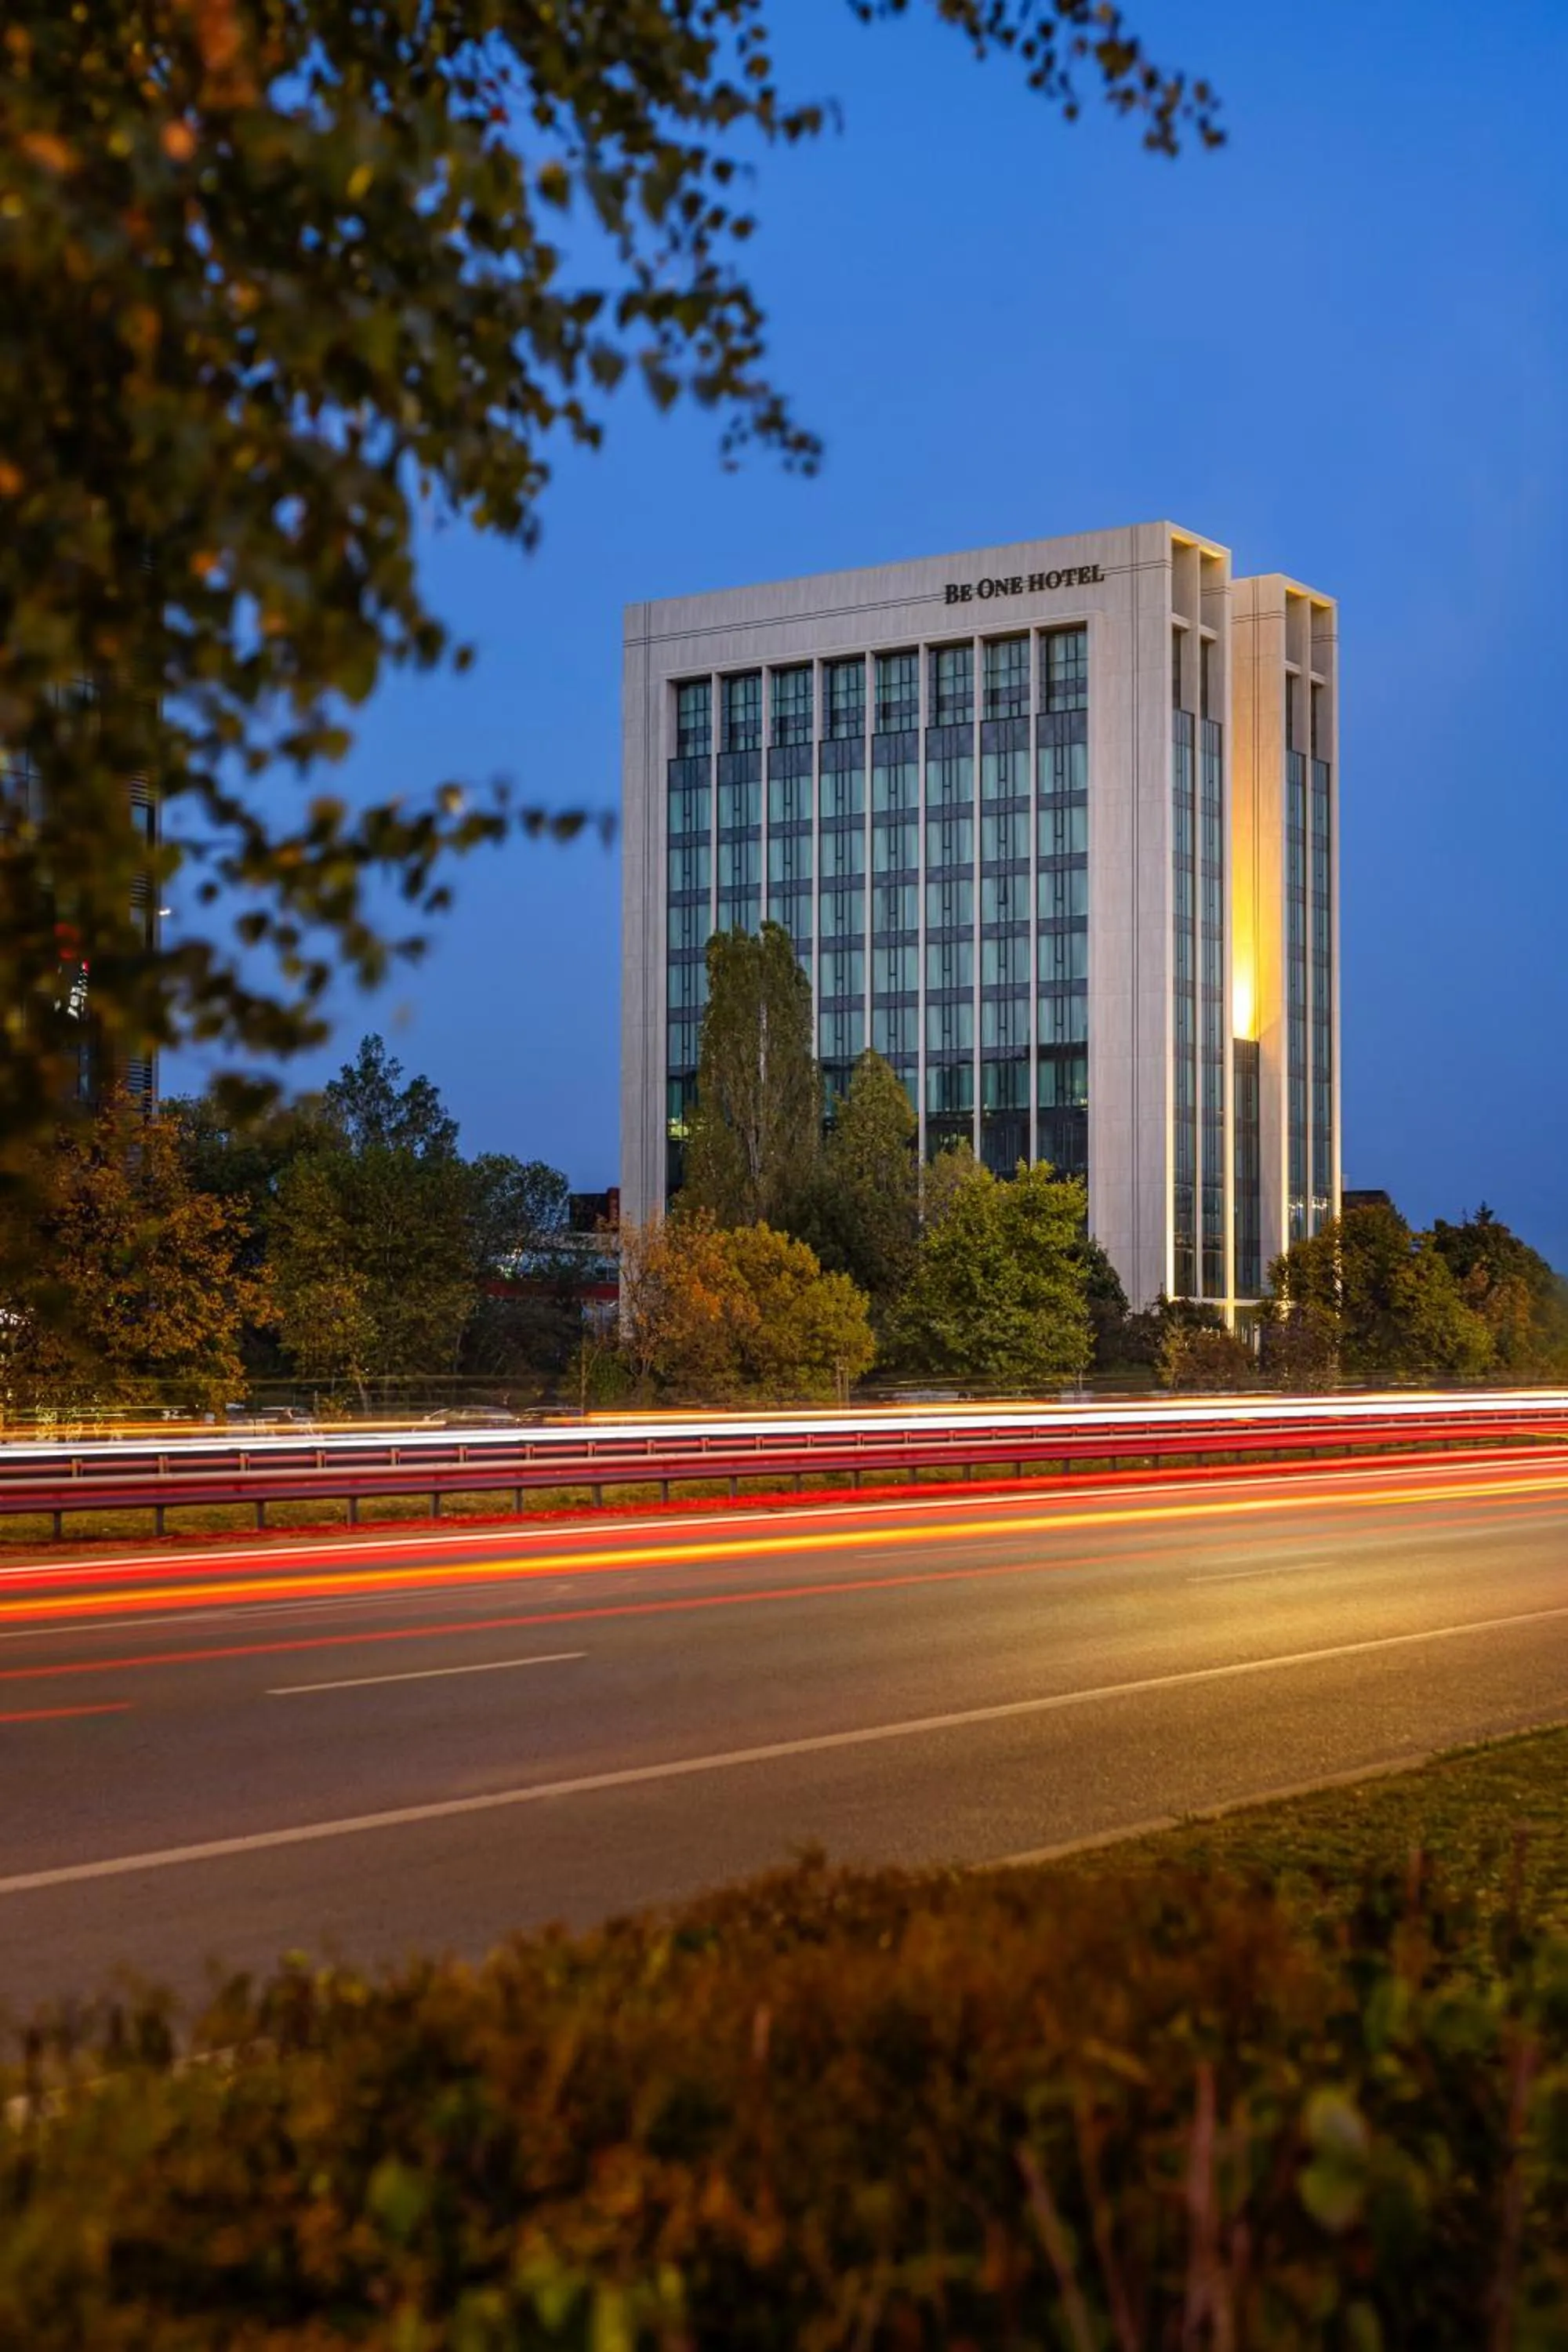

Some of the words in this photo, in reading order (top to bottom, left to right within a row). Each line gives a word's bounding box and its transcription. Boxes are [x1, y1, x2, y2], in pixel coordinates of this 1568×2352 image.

[945, 583, 972, 604] BE
[978, 576, 1023, 599] ONE
[1028, 564, 1105, 592] HOTEL
